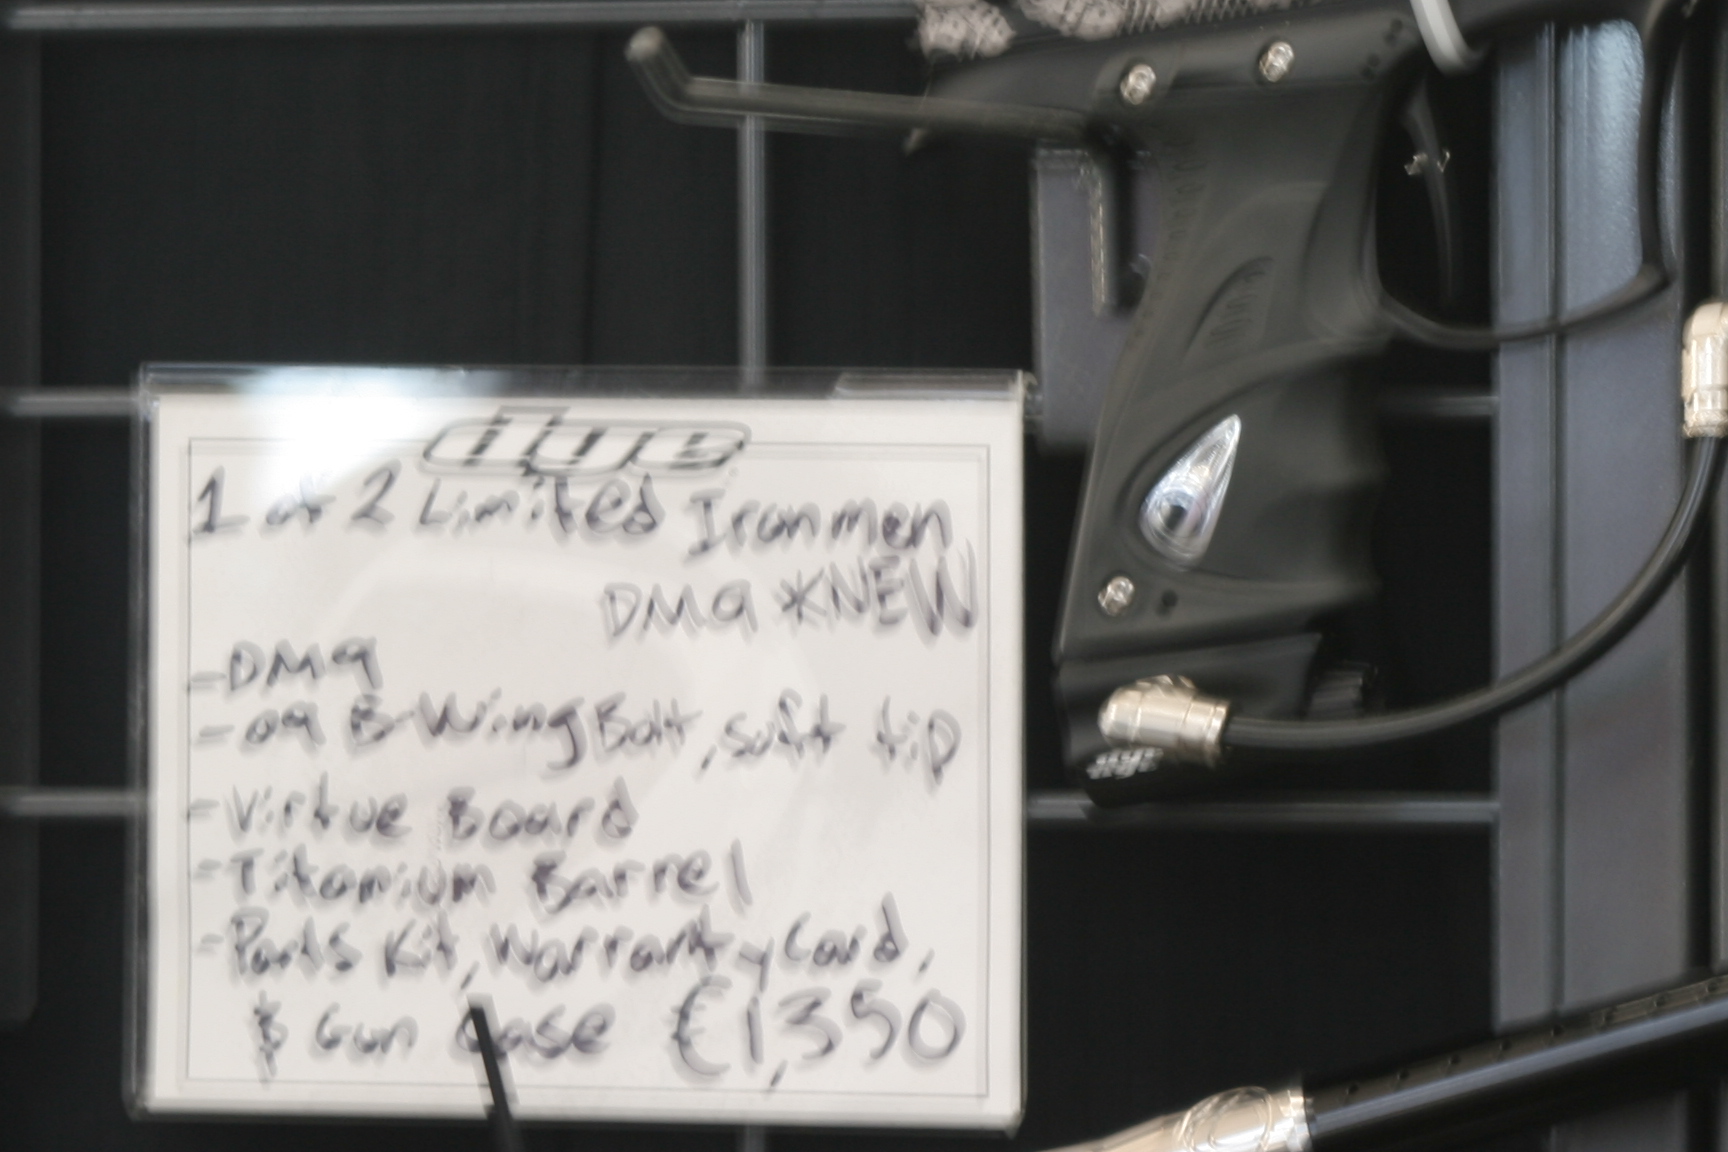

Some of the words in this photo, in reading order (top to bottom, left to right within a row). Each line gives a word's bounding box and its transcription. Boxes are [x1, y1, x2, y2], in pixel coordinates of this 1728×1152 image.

[352, 460, 400, 528] 2
[418, 472, 666, 538] Limited
[446, 778, 640, 842] Board
[530, 838, 754, 916] Barrel
